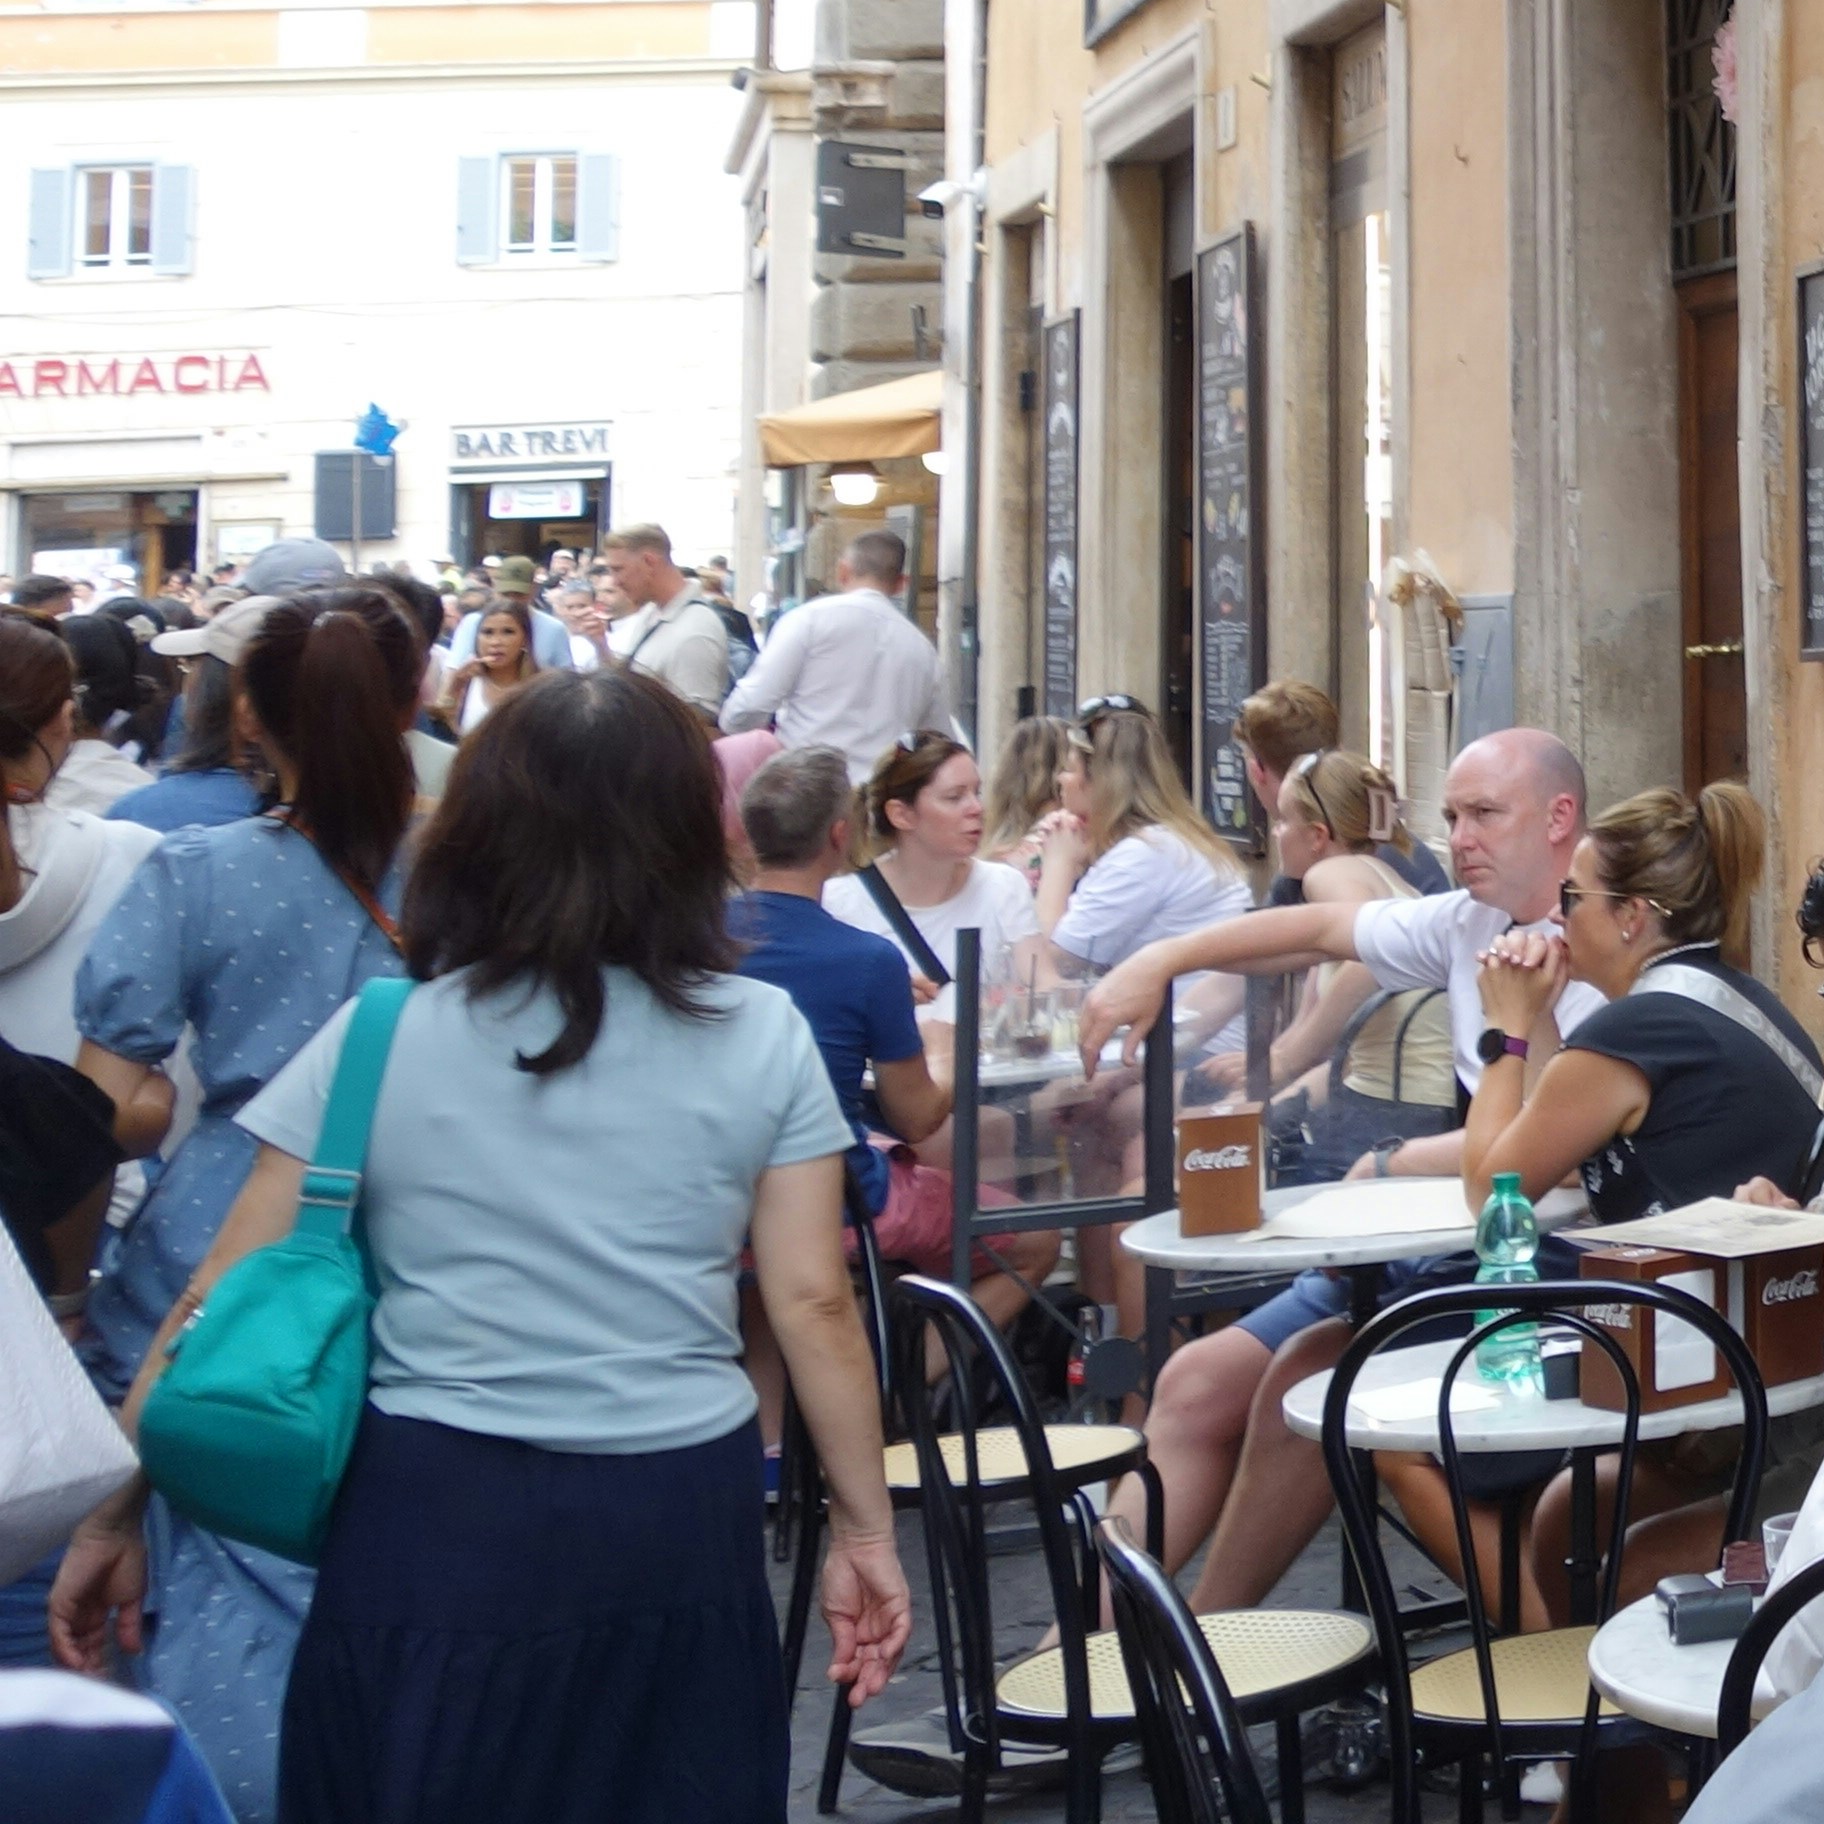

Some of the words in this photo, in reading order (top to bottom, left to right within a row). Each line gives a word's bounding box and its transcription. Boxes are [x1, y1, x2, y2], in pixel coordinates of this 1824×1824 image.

[456, 432, 519, 459] BAR
[522, 427, 609, 457] TREVI
[1762, 1269, 1819, 1305] Coca-Cola
